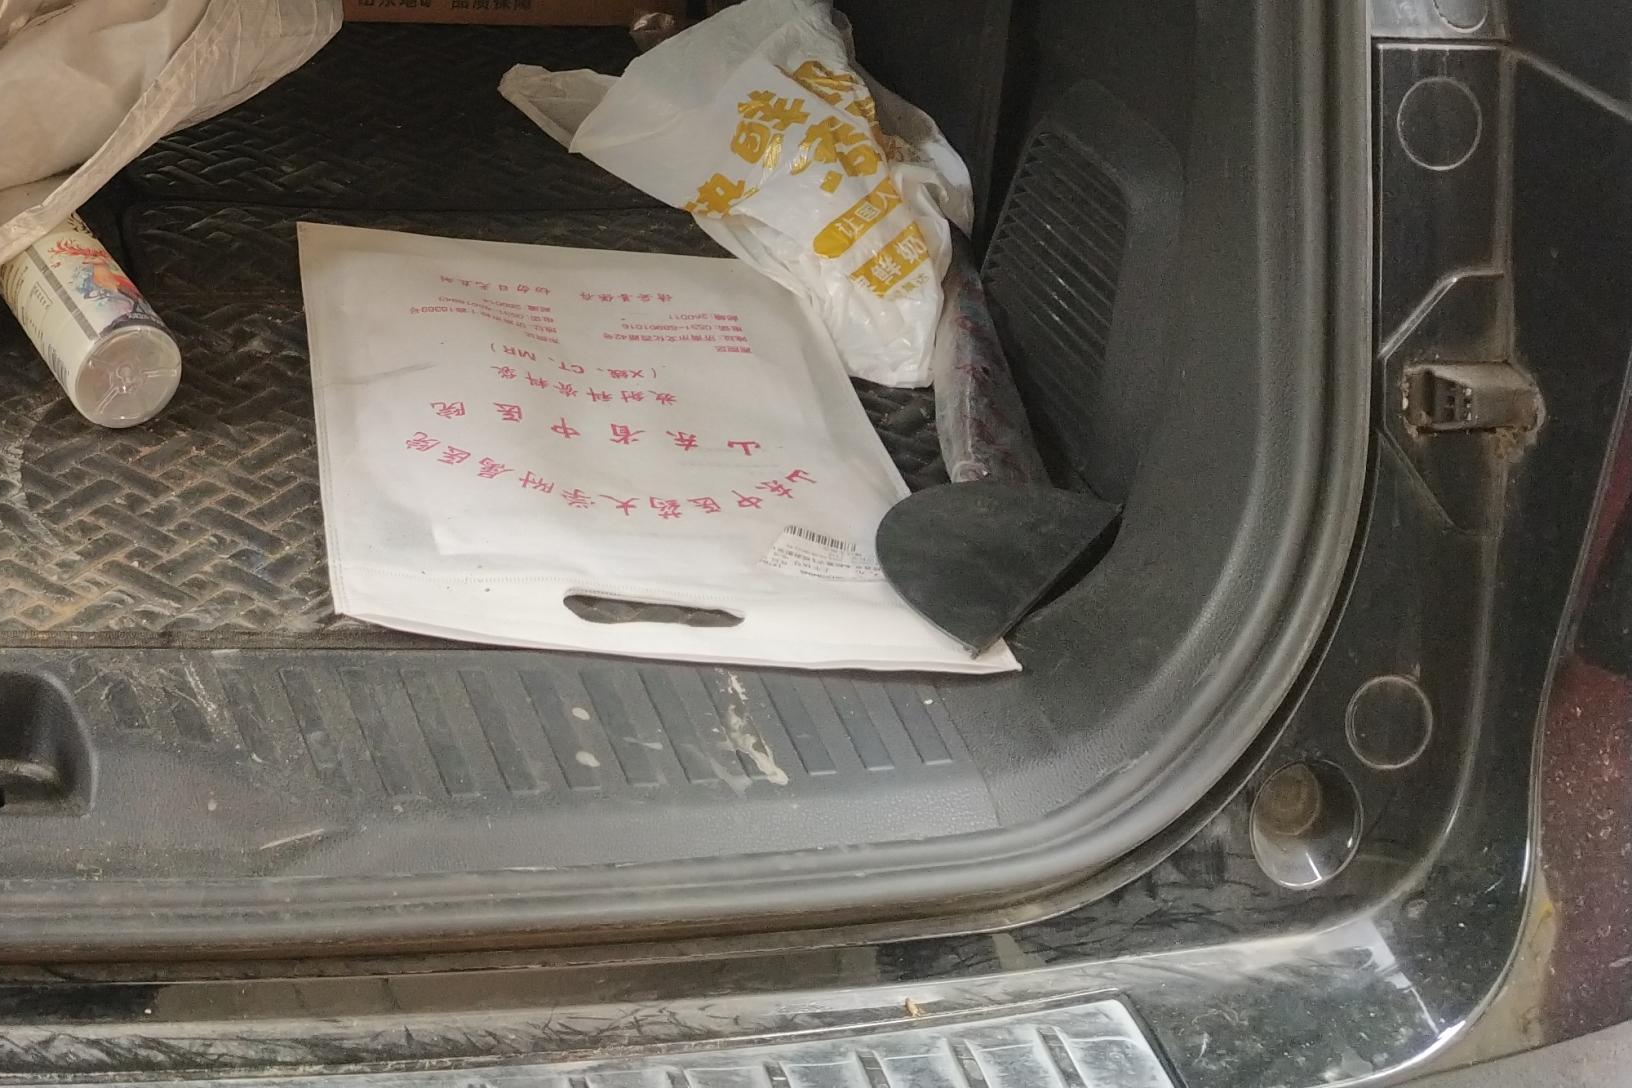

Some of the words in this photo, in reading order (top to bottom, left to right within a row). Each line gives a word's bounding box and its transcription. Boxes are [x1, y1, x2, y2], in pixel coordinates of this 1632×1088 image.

[491, 366, 678, 406] 放射科资料袋
[430, 401, 761, 457] 山东省中医院
[405, 432, 818, 520] 山东中医药大学附属医院
